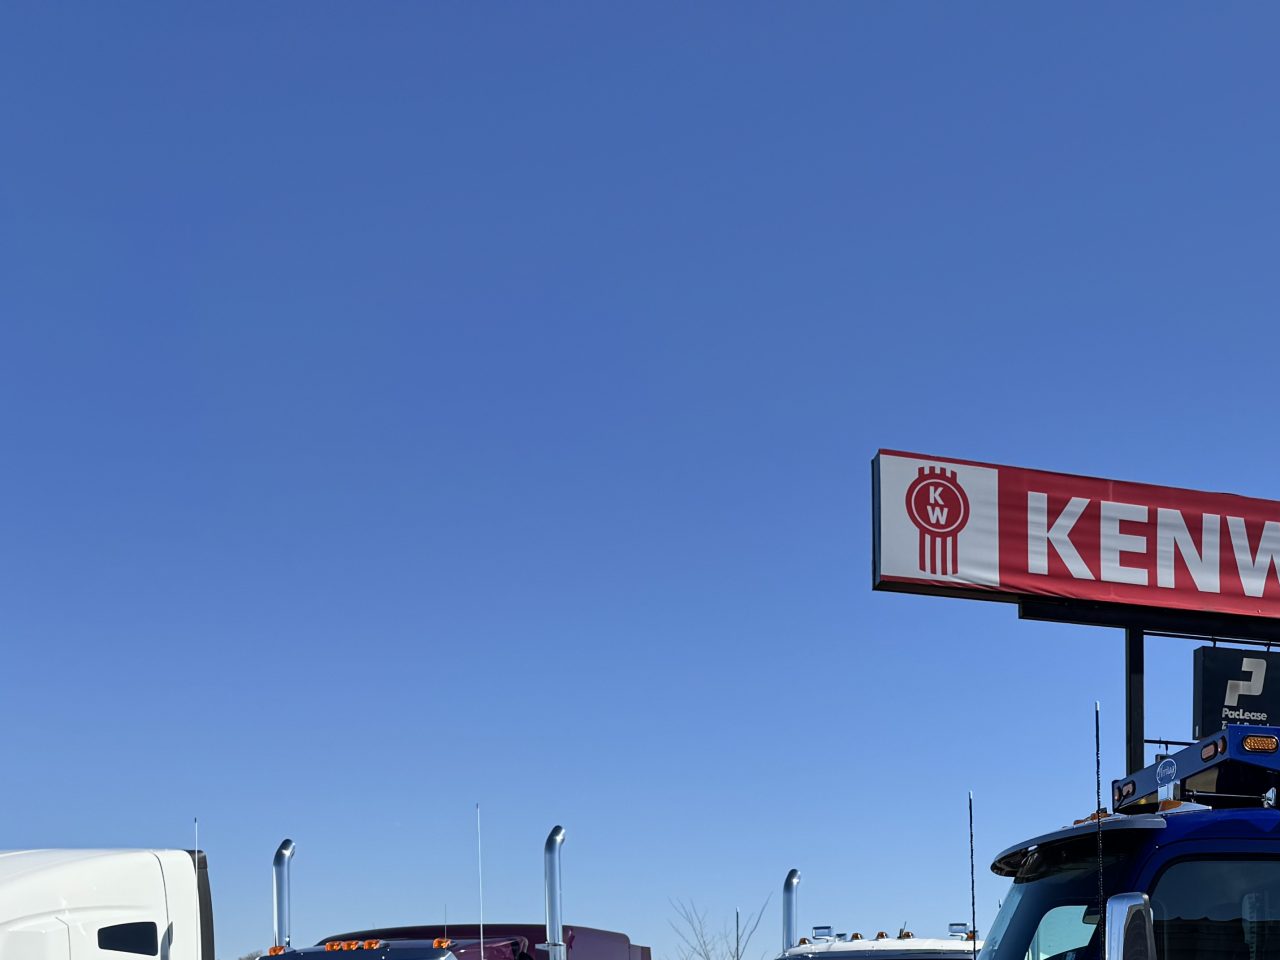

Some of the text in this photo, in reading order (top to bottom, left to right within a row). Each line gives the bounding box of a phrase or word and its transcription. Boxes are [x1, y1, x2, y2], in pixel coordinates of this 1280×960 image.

[929, 486, 945, 505] K
[926, 505, 949, 525] W
[1222, 707, 1268, 721] PacLease
